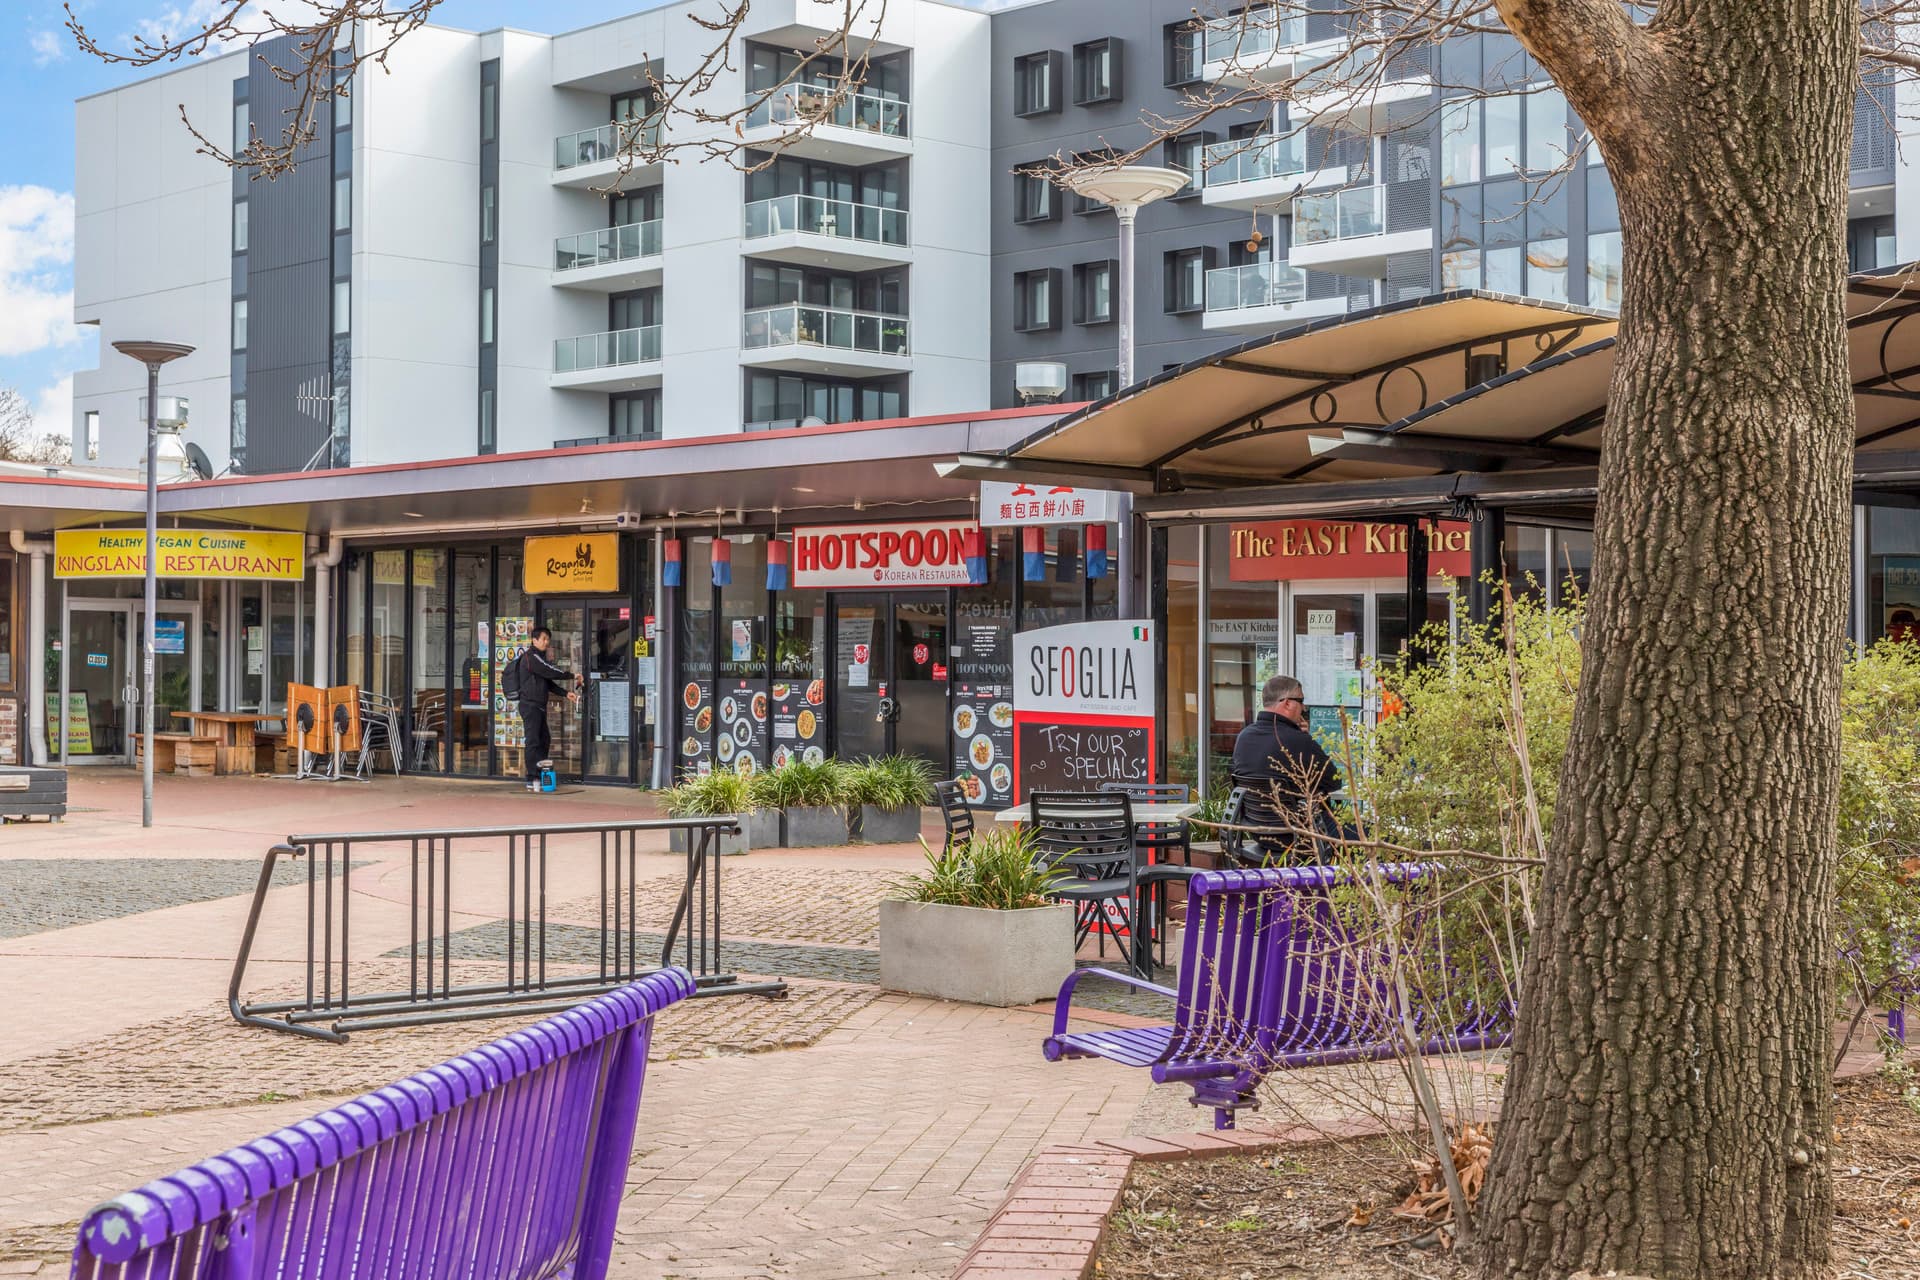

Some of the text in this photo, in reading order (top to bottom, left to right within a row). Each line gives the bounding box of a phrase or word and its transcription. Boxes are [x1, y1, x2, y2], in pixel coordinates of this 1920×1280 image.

[1000, 498, 1085, 519] 麵包西餅小廚
[797, 527, 973, 571] HOTSPOON
[1231, 522, 1472, 559] The EAST Kithe
[58, 555, 295, 574] KINGSLAN RESTAURANT
[884, 569, 968, 581] KOREAN RESTAURAN
[1209, 622, 1223, 632] The
[1225, 622, 1248, 632] EAST
[1309, 613, 1334, 624] B.Y.O.
[1030, 645, 1137, 700] SFOGLIA
[1039, 725, 1127, 757] TRY OUR
[1063, 756, 1148, 780] SPECIALS:
